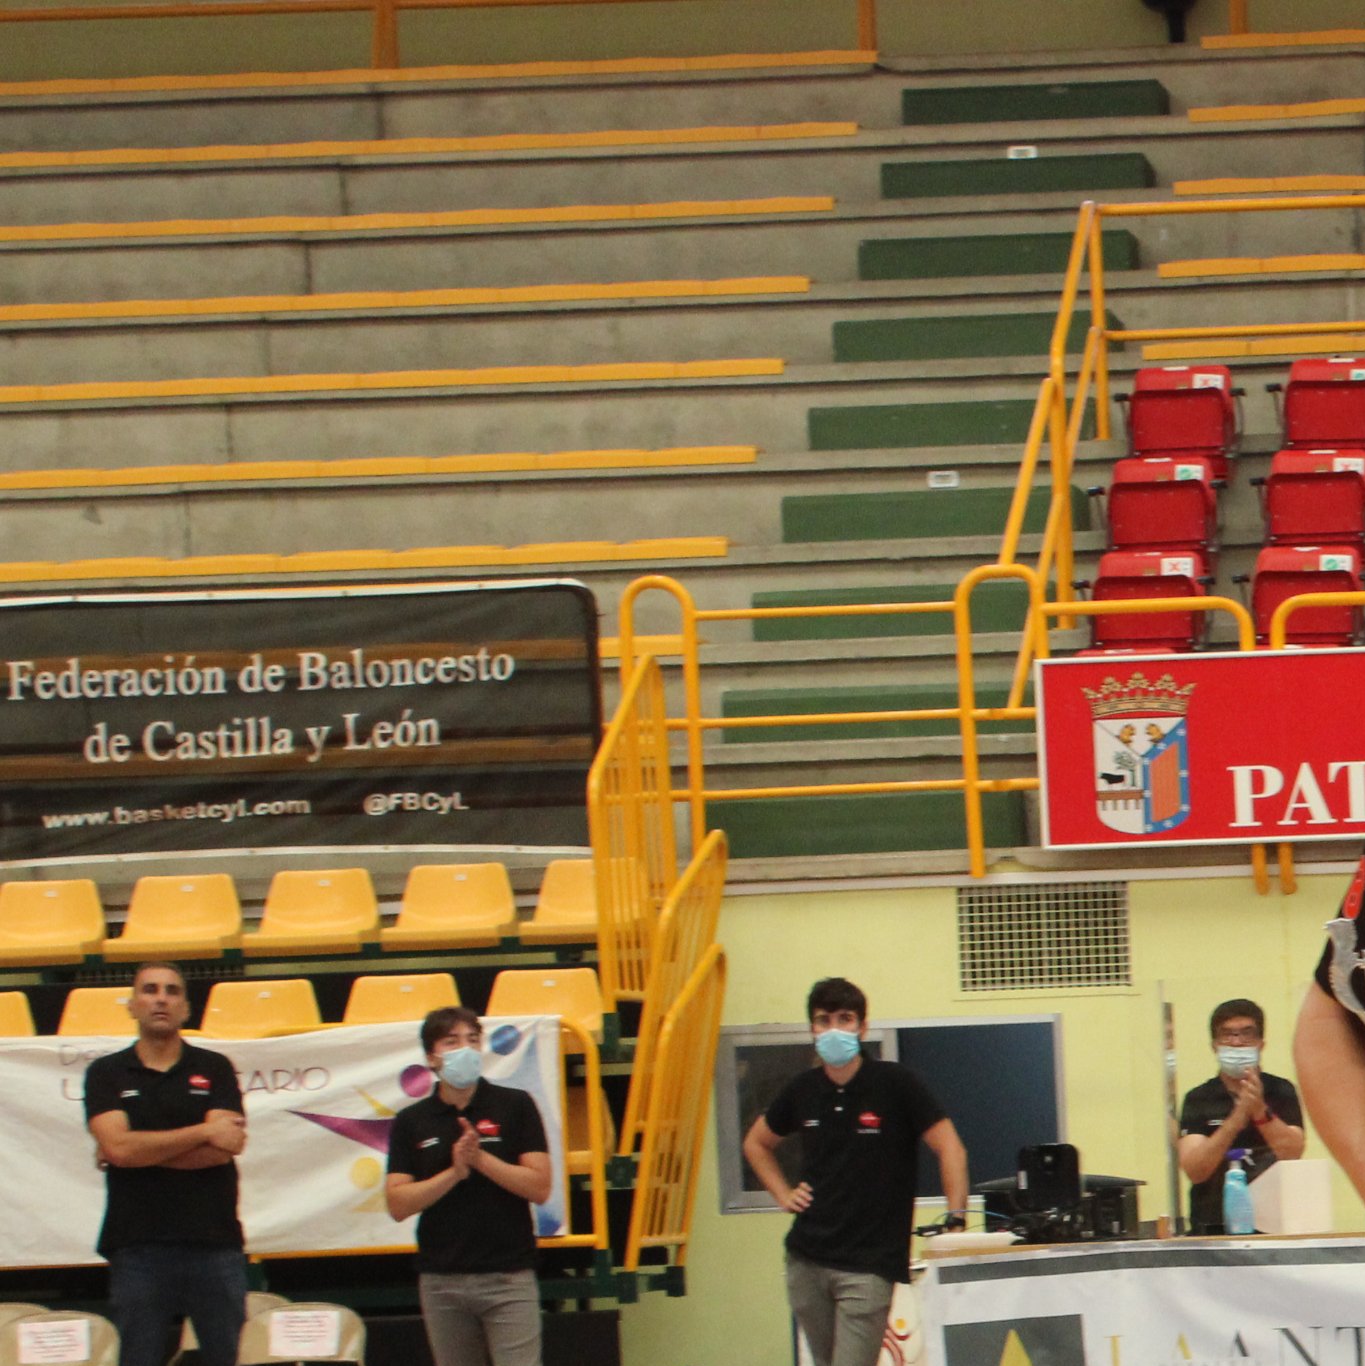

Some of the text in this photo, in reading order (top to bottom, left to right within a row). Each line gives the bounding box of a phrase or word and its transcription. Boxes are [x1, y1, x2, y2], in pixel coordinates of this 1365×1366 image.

[6, 647, 514, 700] Federación de Baloncesto
[84, 709, 440, 764] de Castilla y León
[42, 792, 469, 829] www.basketcyl.com @FBCyL
